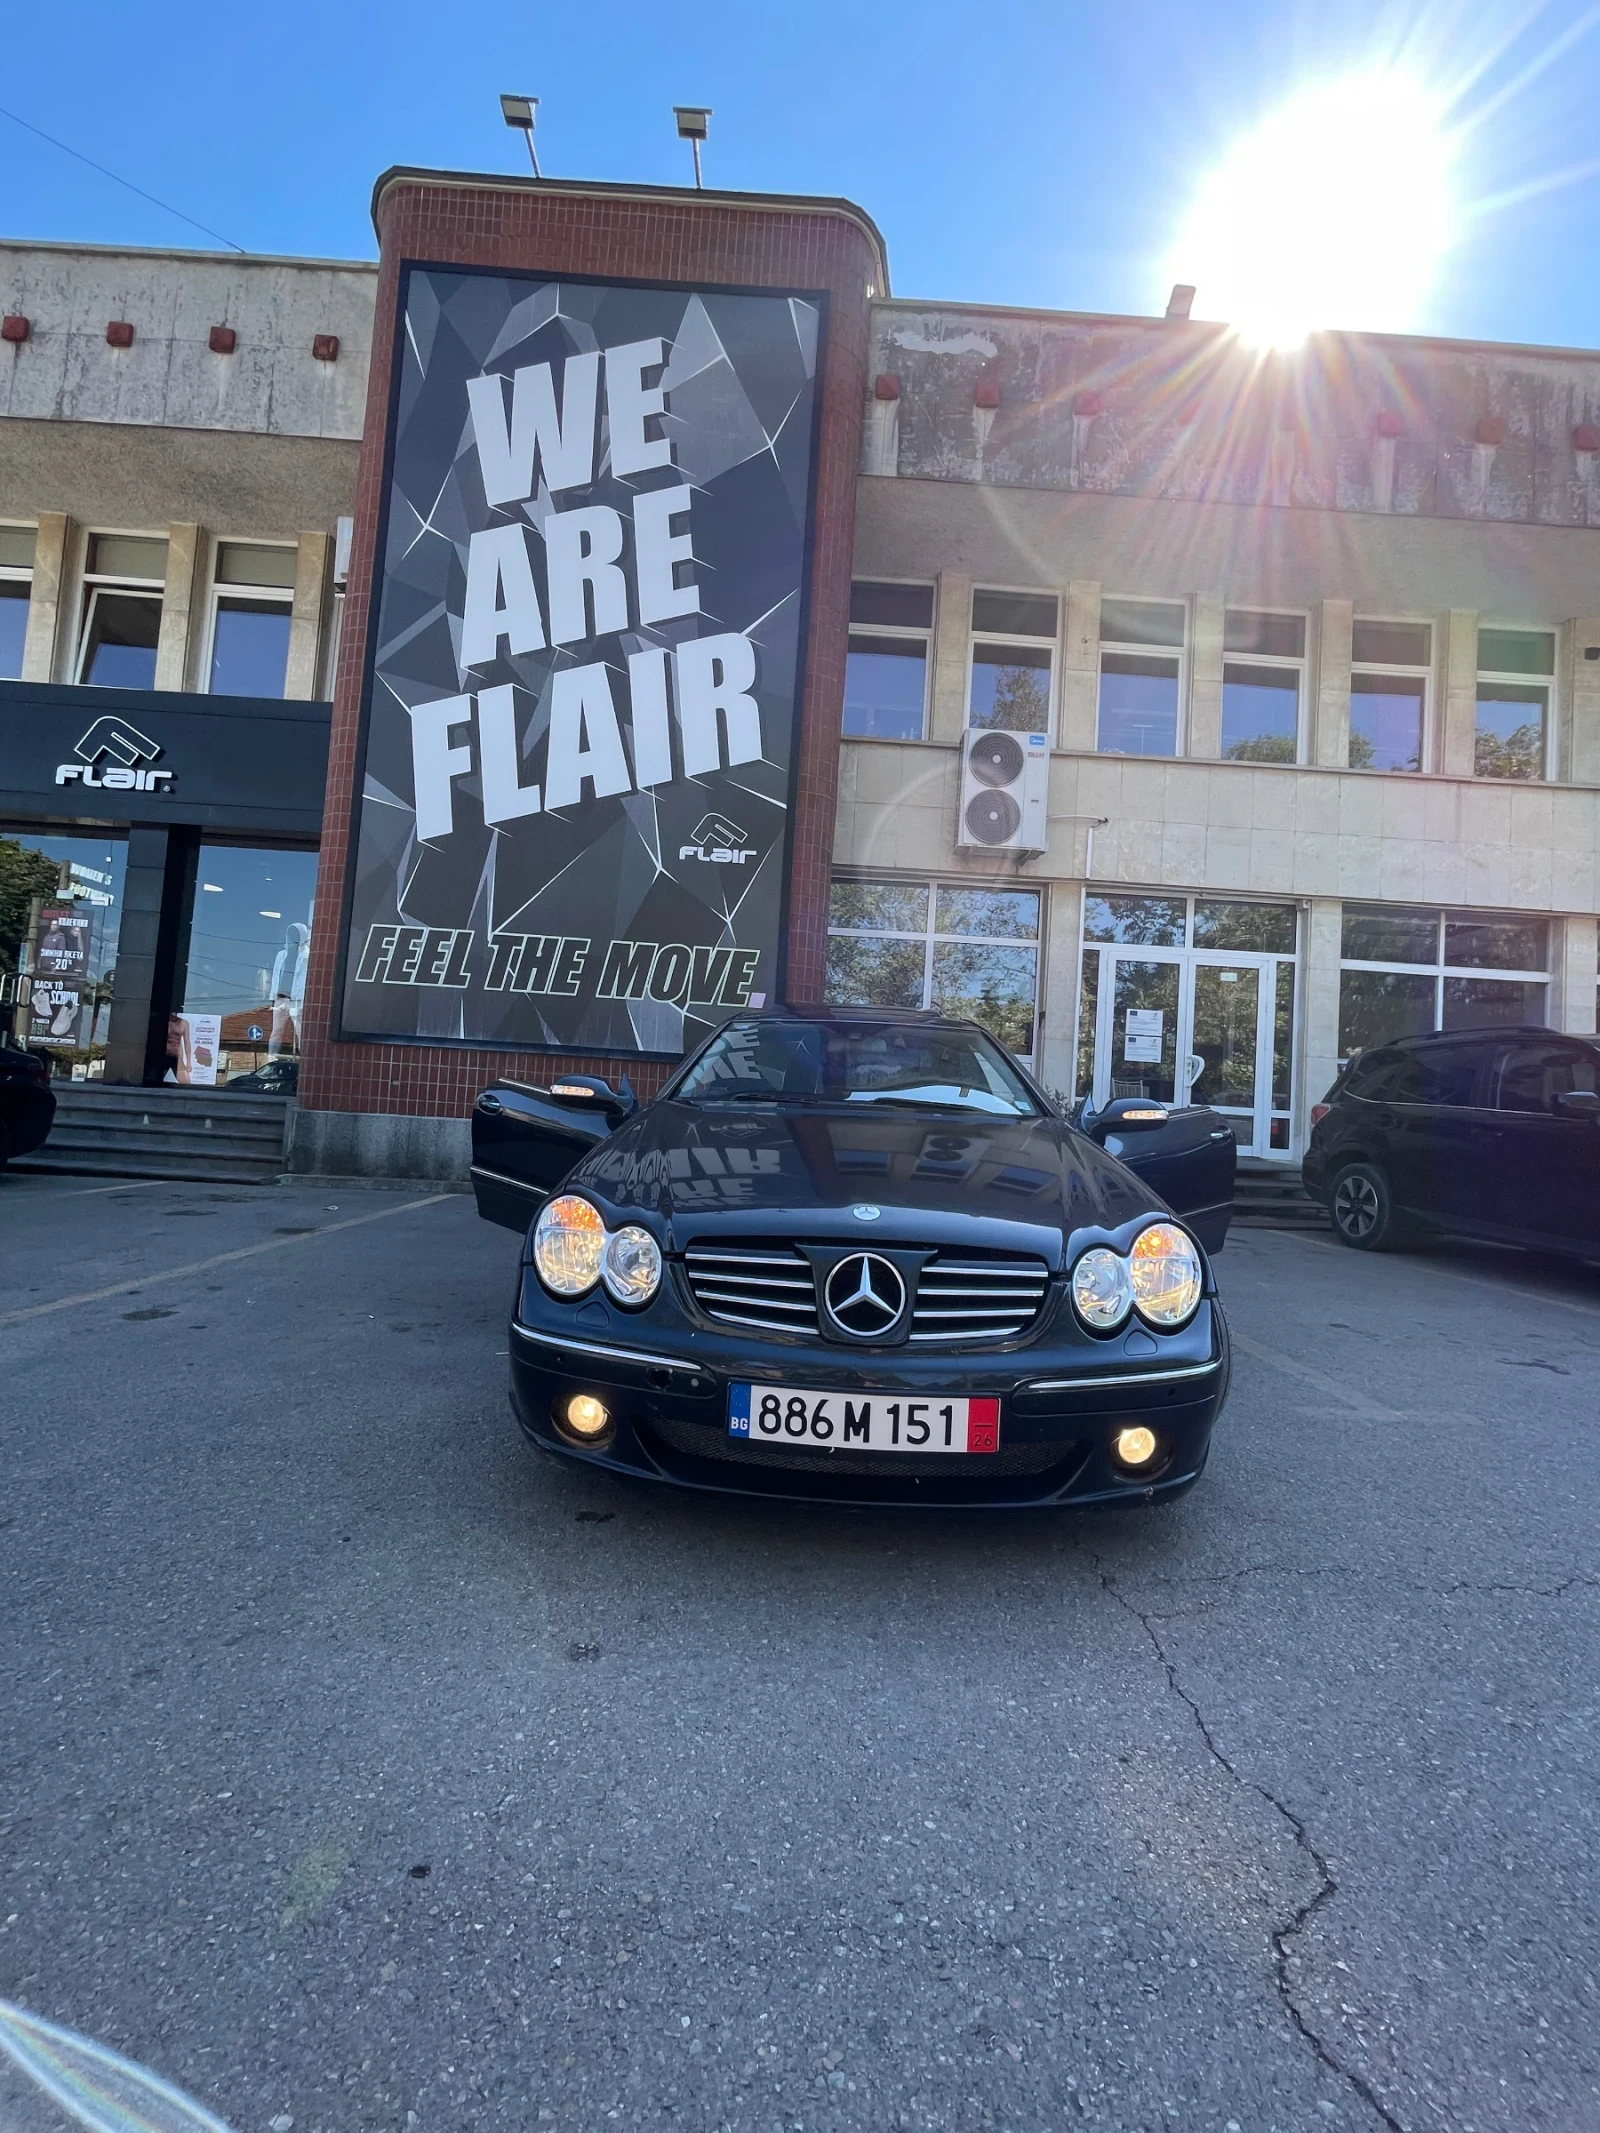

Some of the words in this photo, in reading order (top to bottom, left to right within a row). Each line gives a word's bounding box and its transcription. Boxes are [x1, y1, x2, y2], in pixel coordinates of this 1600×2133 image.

[466, 337, 671, 507] WE
[460, 484, 699, 668] ARE
[411, 632, 762, 841] FLAIR
[34, 980, 53, 989] BACK
[54, 981, 64, 990] TO
[355, 923, 474, 988] FEEL
[484, 932, 591, 996] THE
[596, 940, 766, 1009] MOVE.
[50, 990, 80, 1006] SCHOOL
[731, 1416, 748, 1430] BG
[759, 1394, 834, 1440] 886
[844, 1401, 871, 1443] M
[887, 1403, 953, 1446] 151
[974, 1434, 992, 1447] 26
